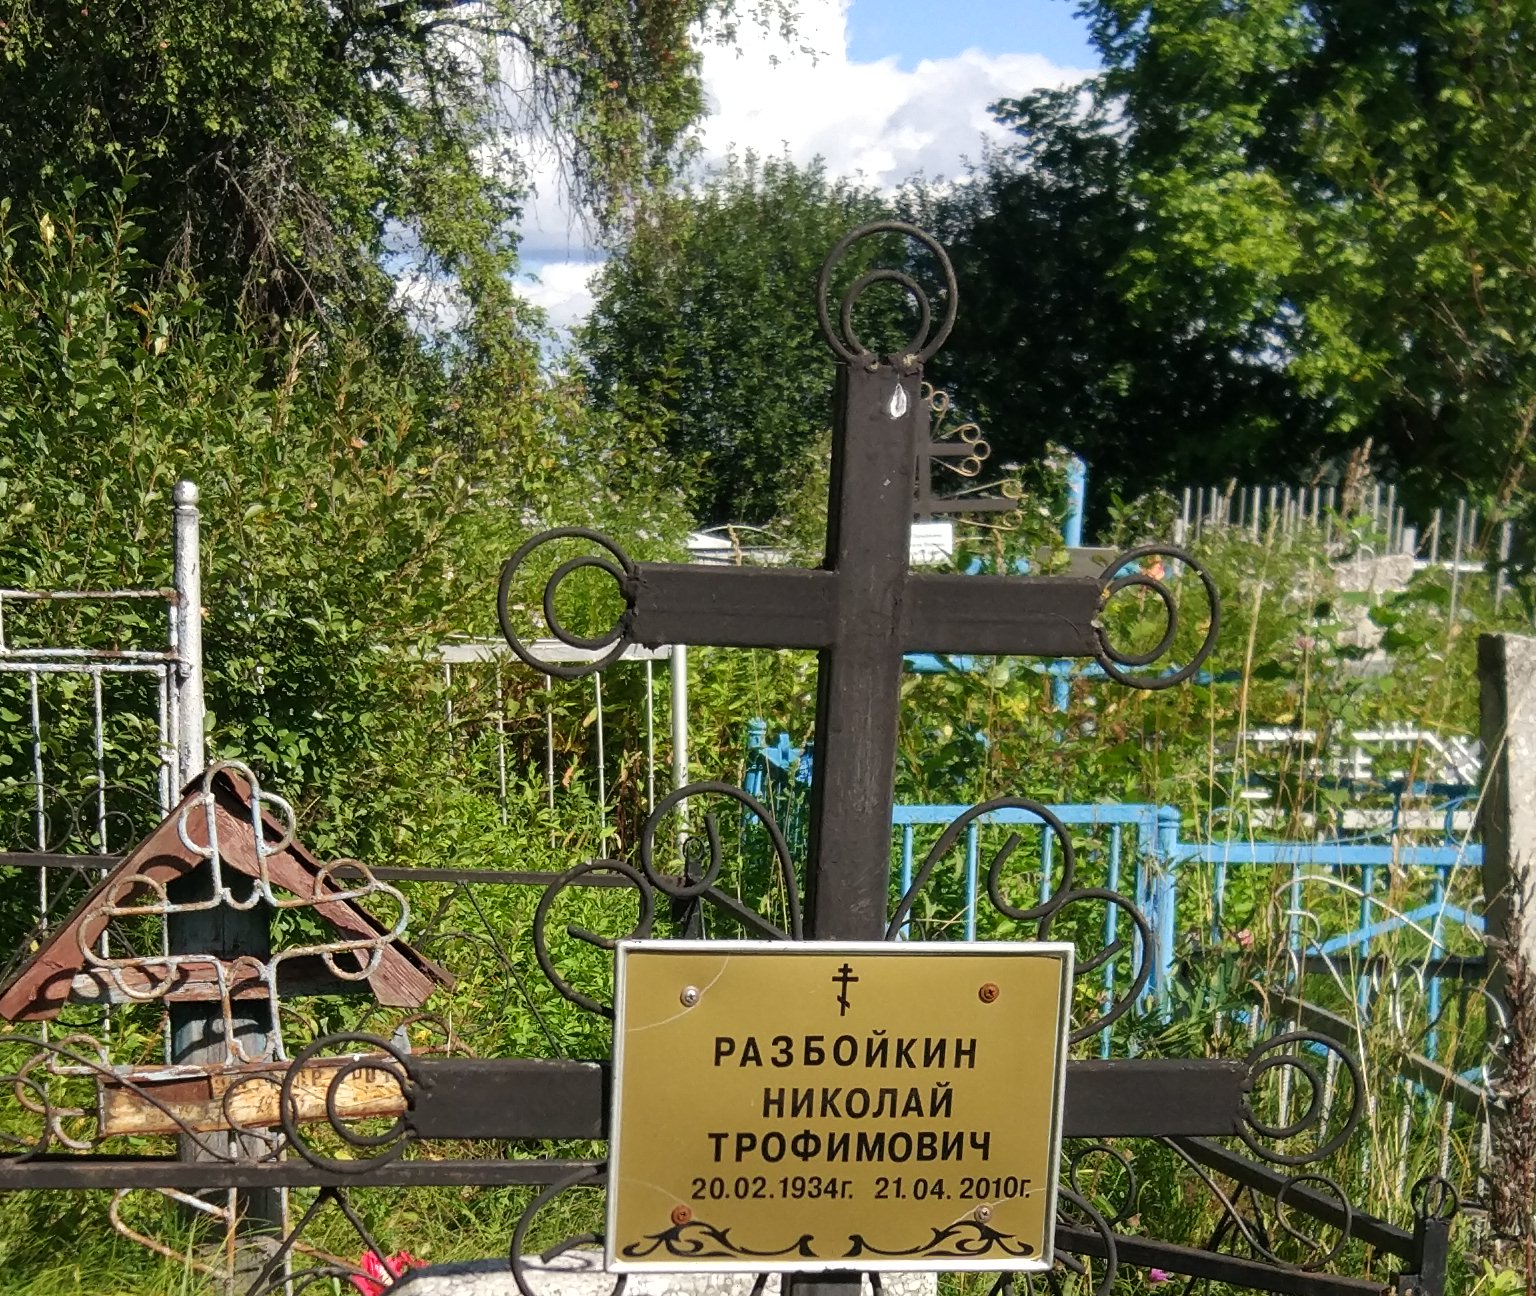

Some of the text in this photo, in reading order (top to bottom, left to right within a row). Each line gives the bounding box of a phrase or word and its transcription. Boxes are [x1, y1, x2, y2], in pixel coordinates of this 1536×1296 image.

[714, 1030, 977, 1069] РАЗБОЙКИН
[762, 1081, 954, 1119] НИКОЛАЙ
[707, 1129, 991, 1163] ТРОФИМОВИЧ
